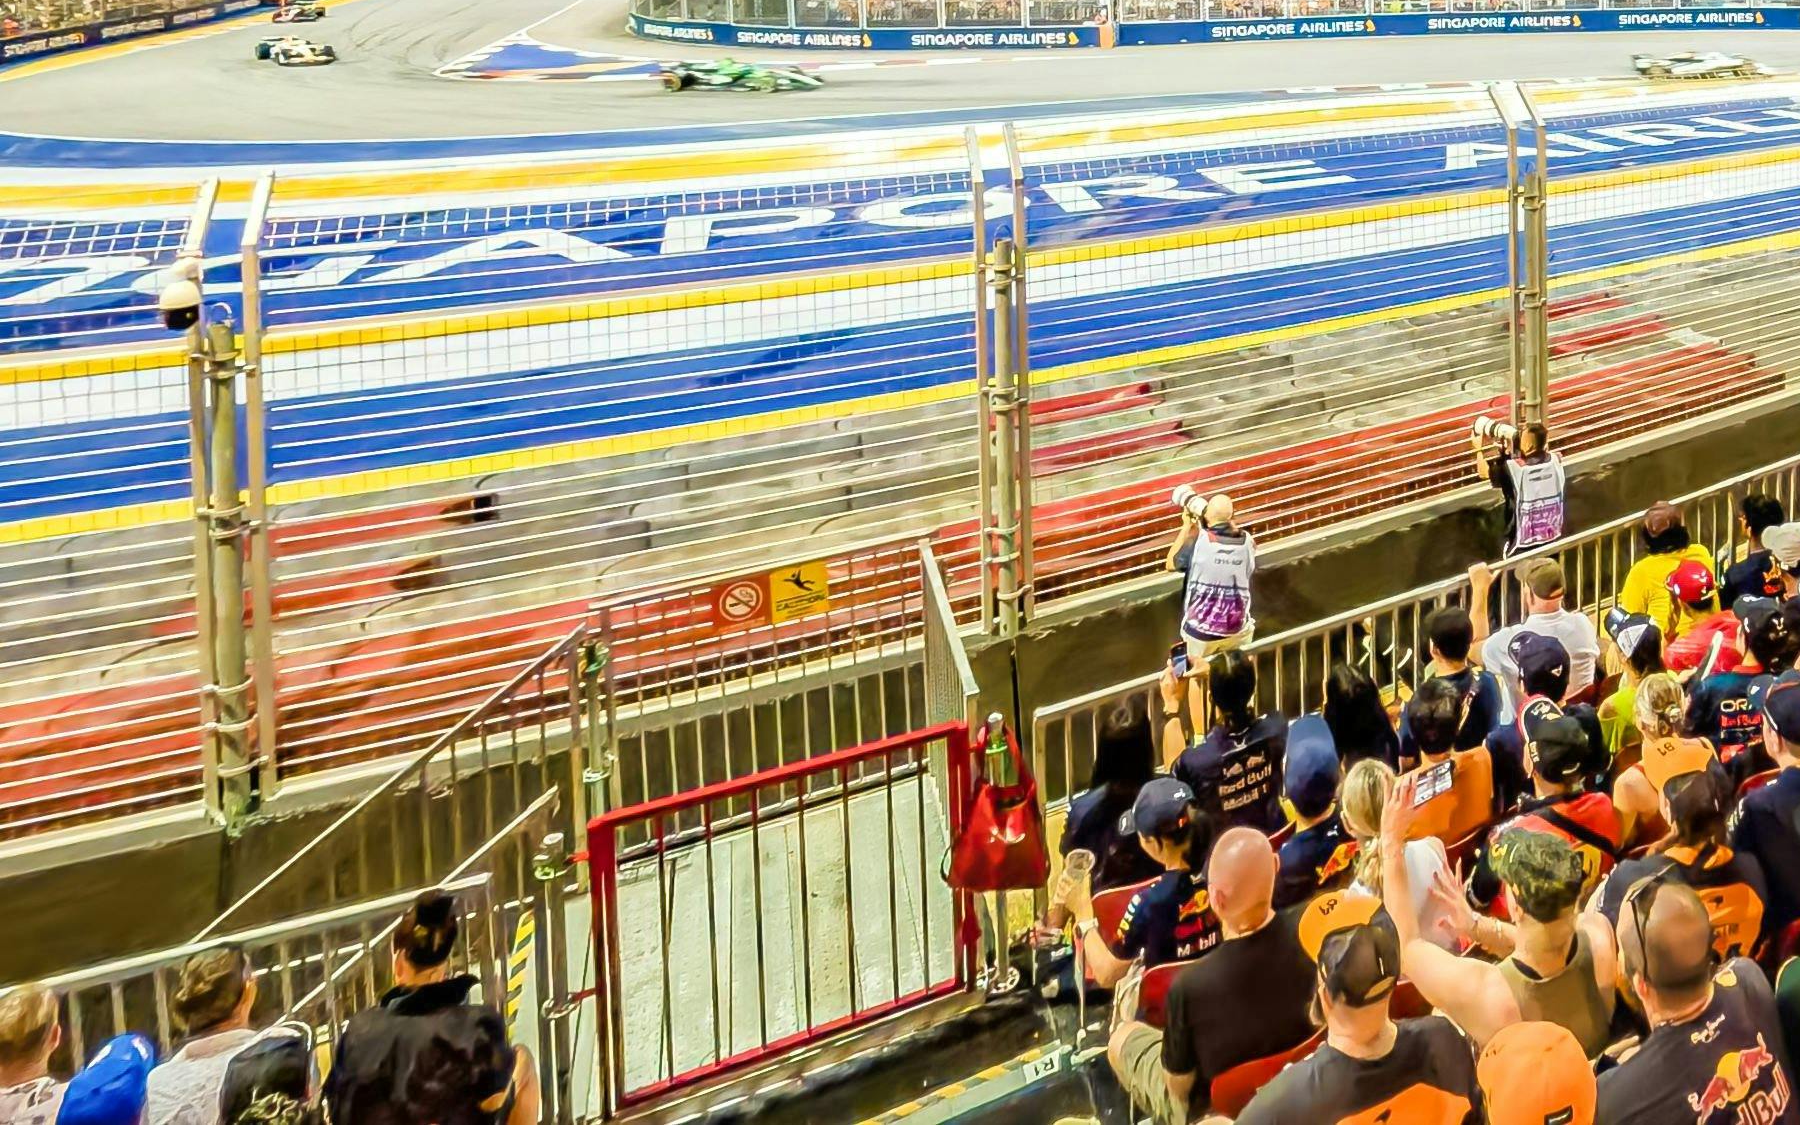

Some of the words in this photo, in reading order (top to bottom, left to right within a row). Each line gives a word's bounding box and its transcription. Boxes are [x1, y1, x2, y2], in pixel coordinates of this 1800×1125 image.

[1428, 17, 1506, 30] SINGAPORE
[1509, 15, 1571, 28] AIRLINES
[1618, 13, 1693, 25] SINGAPORE
[1695, 12, 1754, 24] AIRLINES
[1211, 24, 1295, 38] SINGAPORE
[1300, 20, 1365, 35] AIRLINES
[737, 31, 800, 45] SINGAPORE
[804, 33, 861, 47] AIRLINES
[911, 33, 994, 47] SINGAPORE
[998, 31, 1066, 46] AIRLINES
